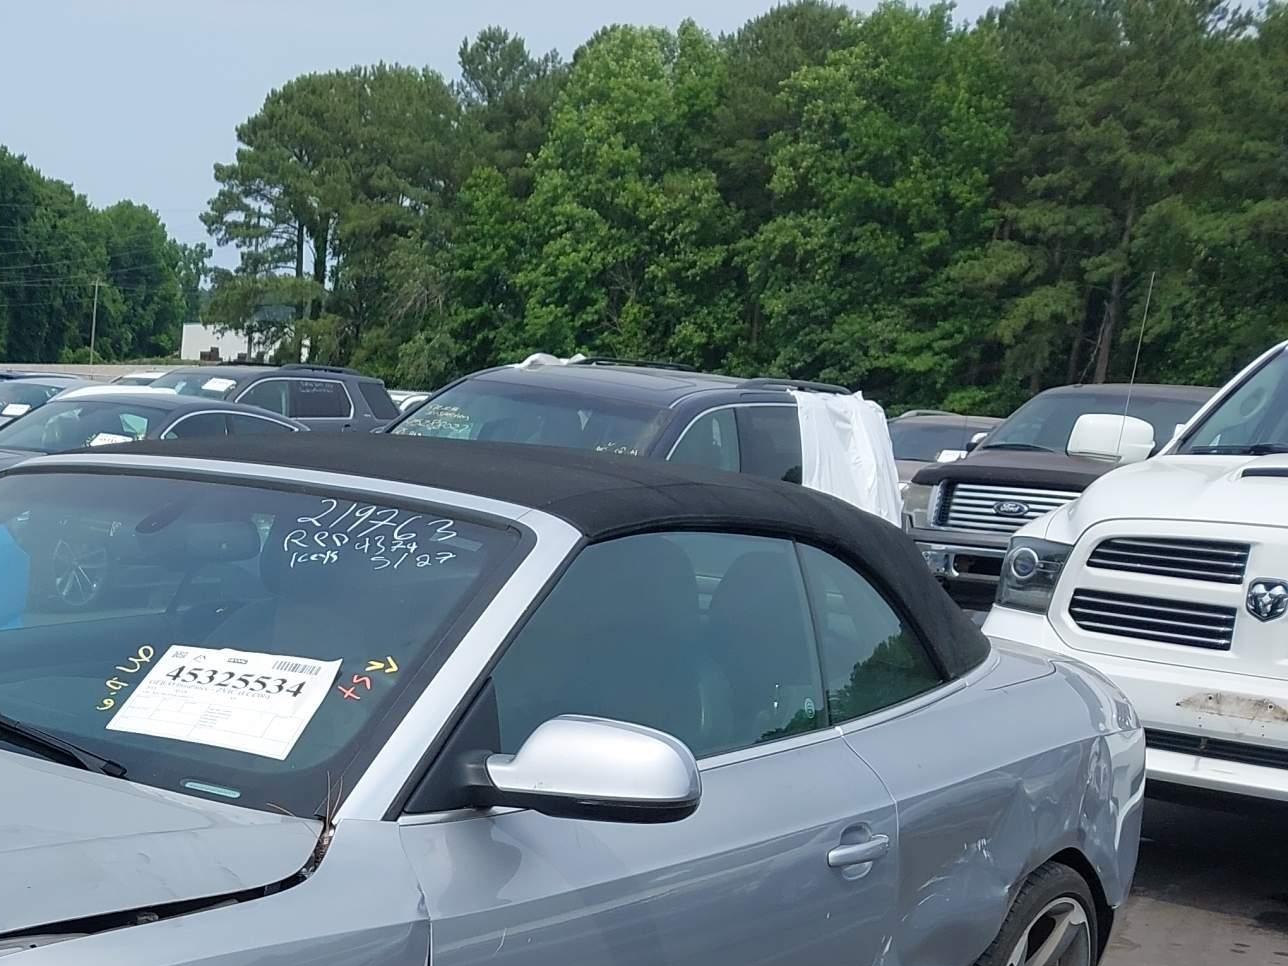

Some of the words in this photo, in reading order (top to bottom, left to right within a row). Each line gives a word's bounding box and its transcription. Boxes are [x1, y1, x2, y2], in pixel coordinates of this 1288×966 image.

[297, 499, 457, 541] 219763
[355, 536, 418, 555] 4374
[371, 552, 456, 570] 5/27
[165, 665, 307, 698] 45325534
